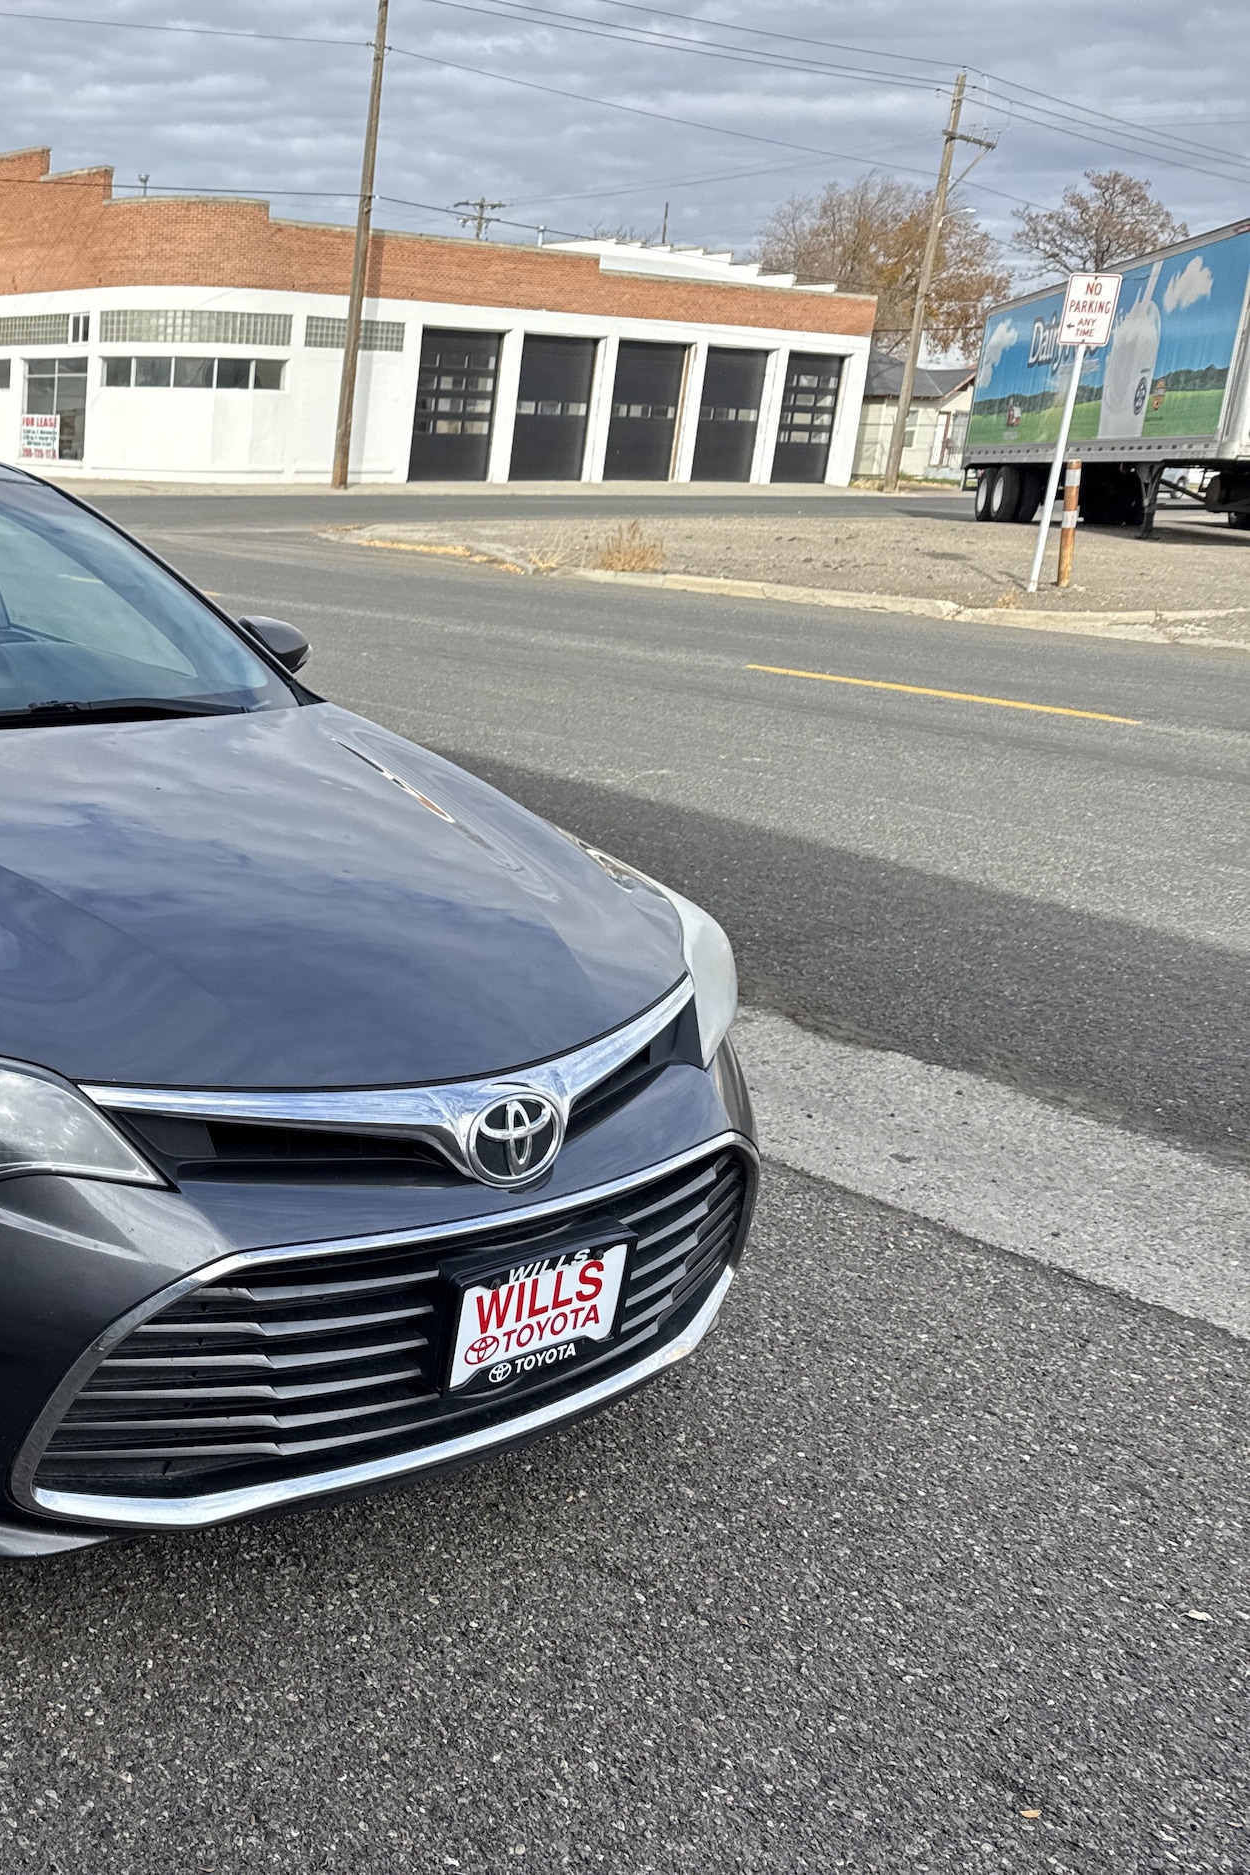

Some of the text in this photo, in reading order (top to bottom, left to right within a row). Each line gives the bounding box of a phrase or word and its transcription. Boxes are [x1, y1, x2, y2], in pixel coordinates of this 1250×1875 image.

[1085, 282, 1103, 296] NO
[1068, 299, 1112, 314] PARKING
[1077, 318, 1098, 327] ANY
[1075, 328, 1095, 337] TIME
[22, 416, 57, 428] FOR LEASE
[508, 1248, 591, 1284] WILLS
[476, 1260, 605, 1335] WILLS
[502, 1304, 600, 1353] TOYOTA
[514, 1342, 577, 1374] TOYOTA
